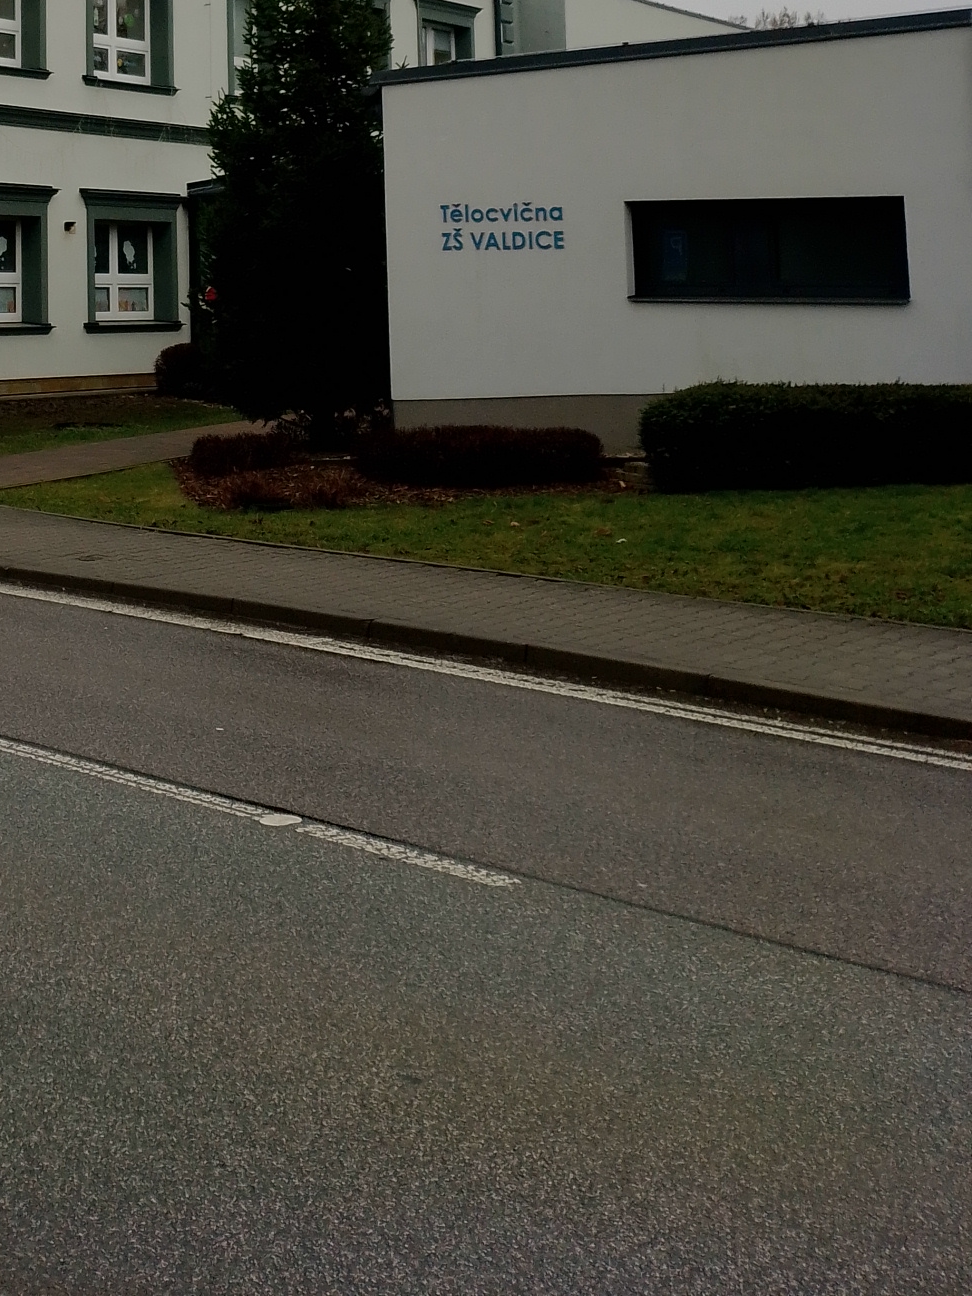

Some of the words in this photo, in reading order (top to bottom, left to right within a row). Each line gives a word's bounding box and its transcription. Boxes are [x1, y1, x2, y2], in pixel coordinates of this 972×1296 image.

[439, 202, 564, 223] Tělocvična
[441, 228, 464, 251] ZŠ
[470, 230, 565, 251] VALDICE
